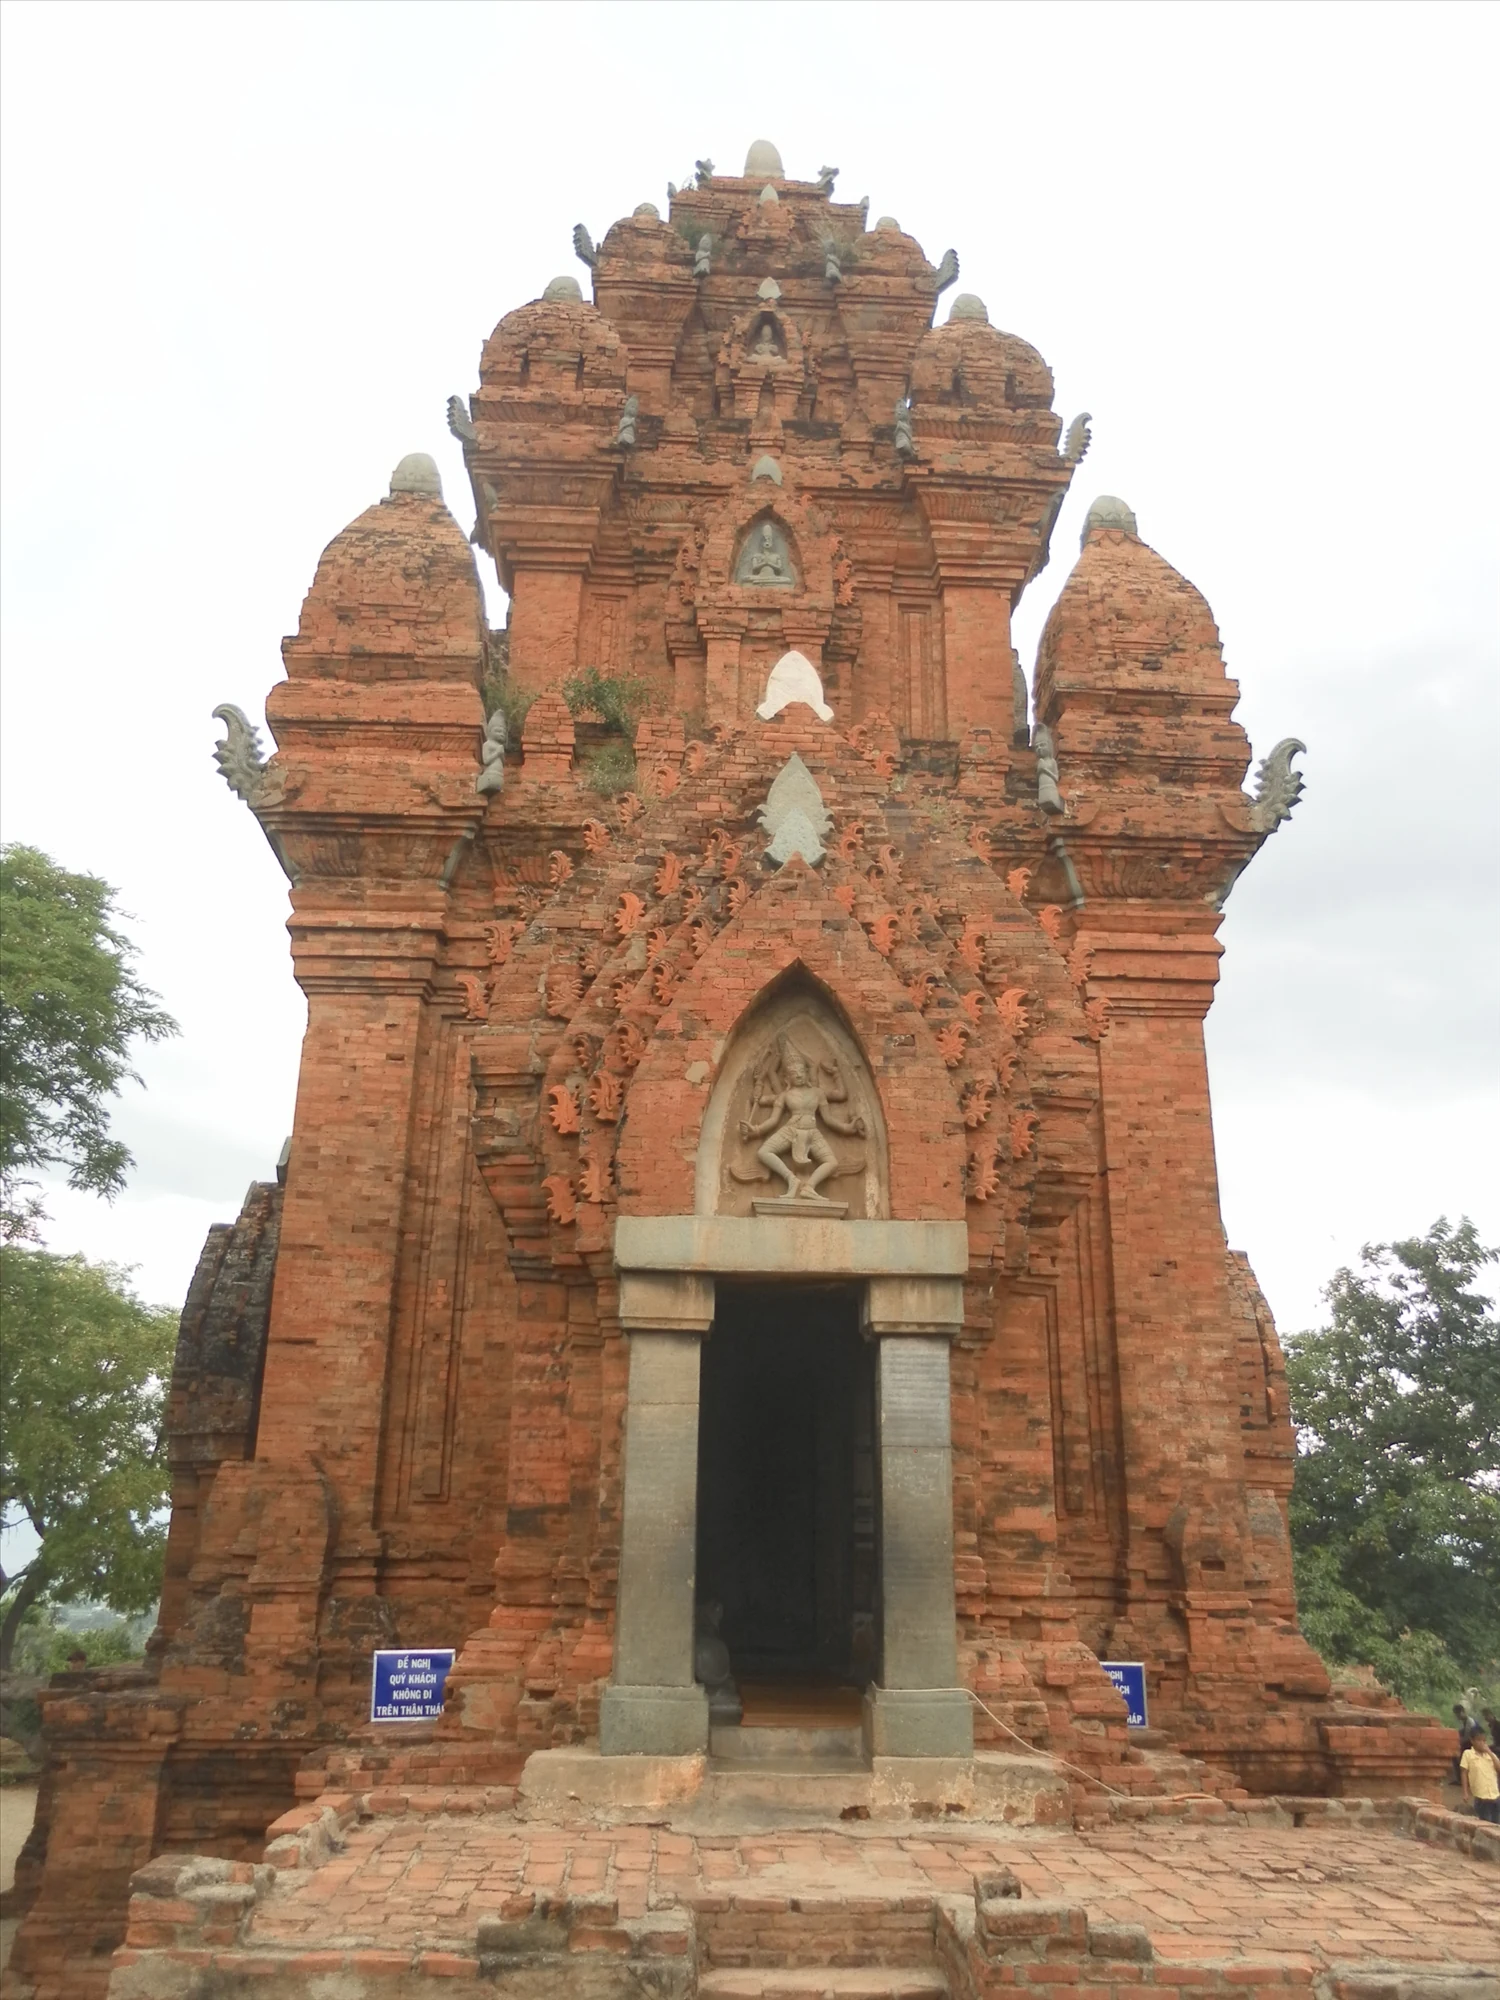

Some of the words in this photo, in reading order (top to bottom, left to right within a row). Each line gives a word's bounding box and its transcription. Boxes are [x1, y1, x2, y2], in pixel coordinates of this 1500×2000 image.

[411, 1658, 431, 1670] NGHỊ
[389, 1672, 406, 1686] QUÝ
[408, 1672, 437, 1684] KHÁCH
[392, 1687, 421, 1700] KHÔNG
[423, 1689, 432, 1699] ĐI
[376, 1703, 399, 1716] TRÊN
[401, 1703, 423, 1715] THÂN
